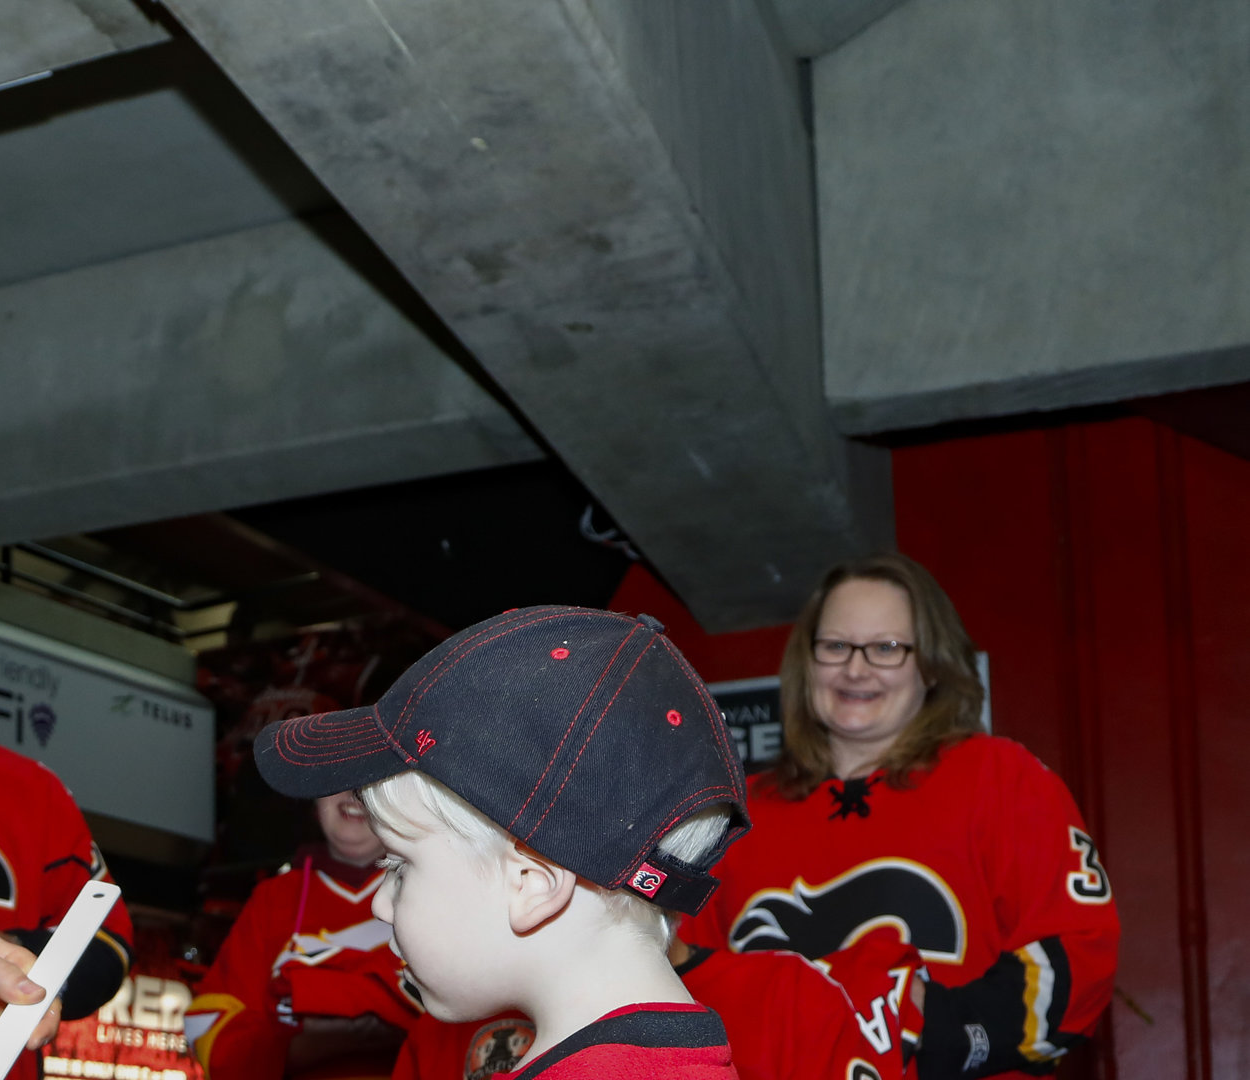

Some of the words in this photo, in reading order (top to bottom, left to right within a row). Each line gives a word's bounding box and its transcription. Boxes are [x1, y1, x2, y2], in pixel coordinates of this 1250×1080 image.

[142, 701, 194, 730] TELUS
[96, 1024, 144, 1048] LIVES
[146, 1030, 189, 1053] HERE
